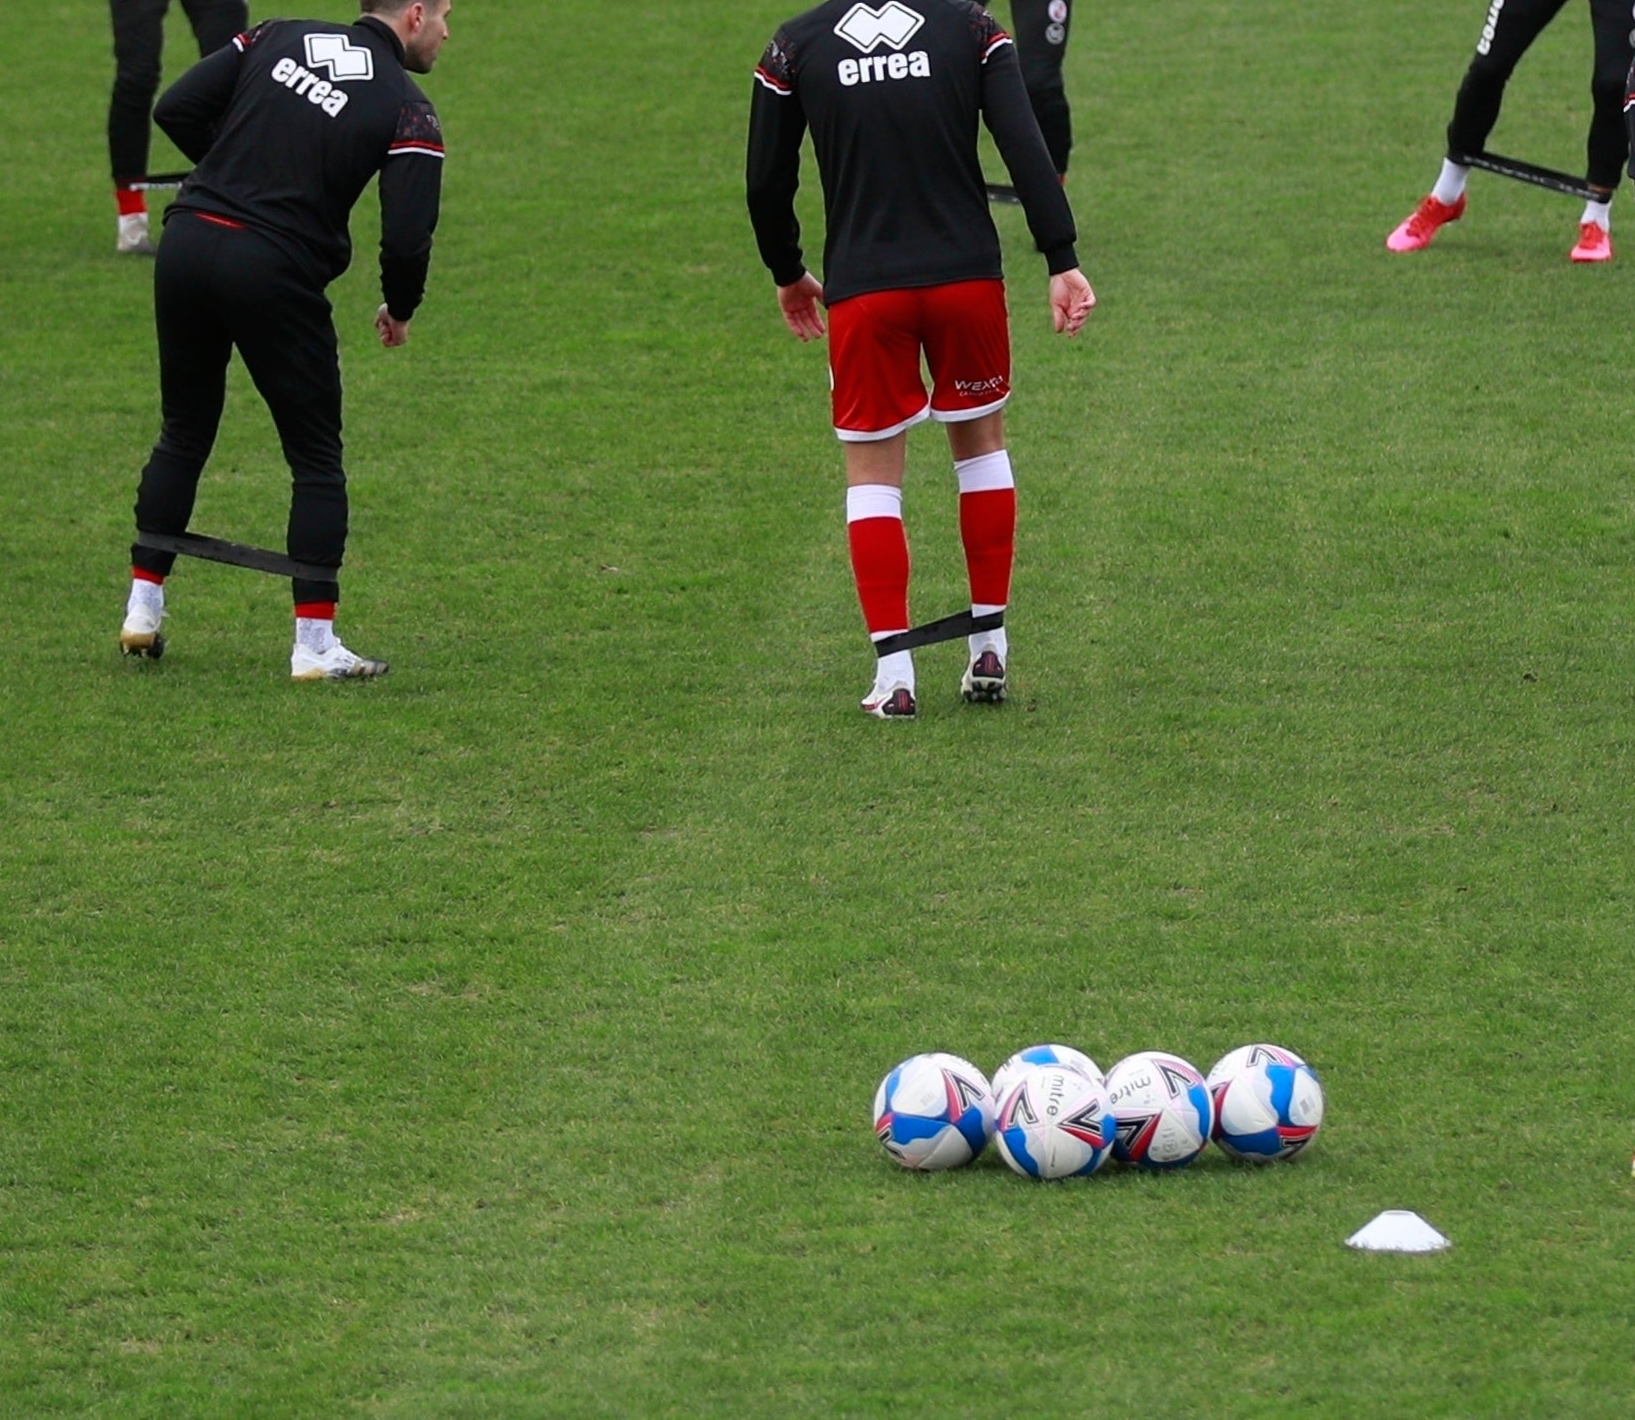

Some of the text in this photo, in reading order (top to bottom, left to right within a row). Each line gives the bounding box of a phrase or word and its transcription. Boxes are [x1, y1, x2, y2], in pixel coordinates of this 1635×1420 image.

[271, 57, 349, 118] errea
[837, 50, 931, 87] errea
[1045, 1074, 1065, 1118] mitre
[1110, 1075, 1152, 1105] mitre
